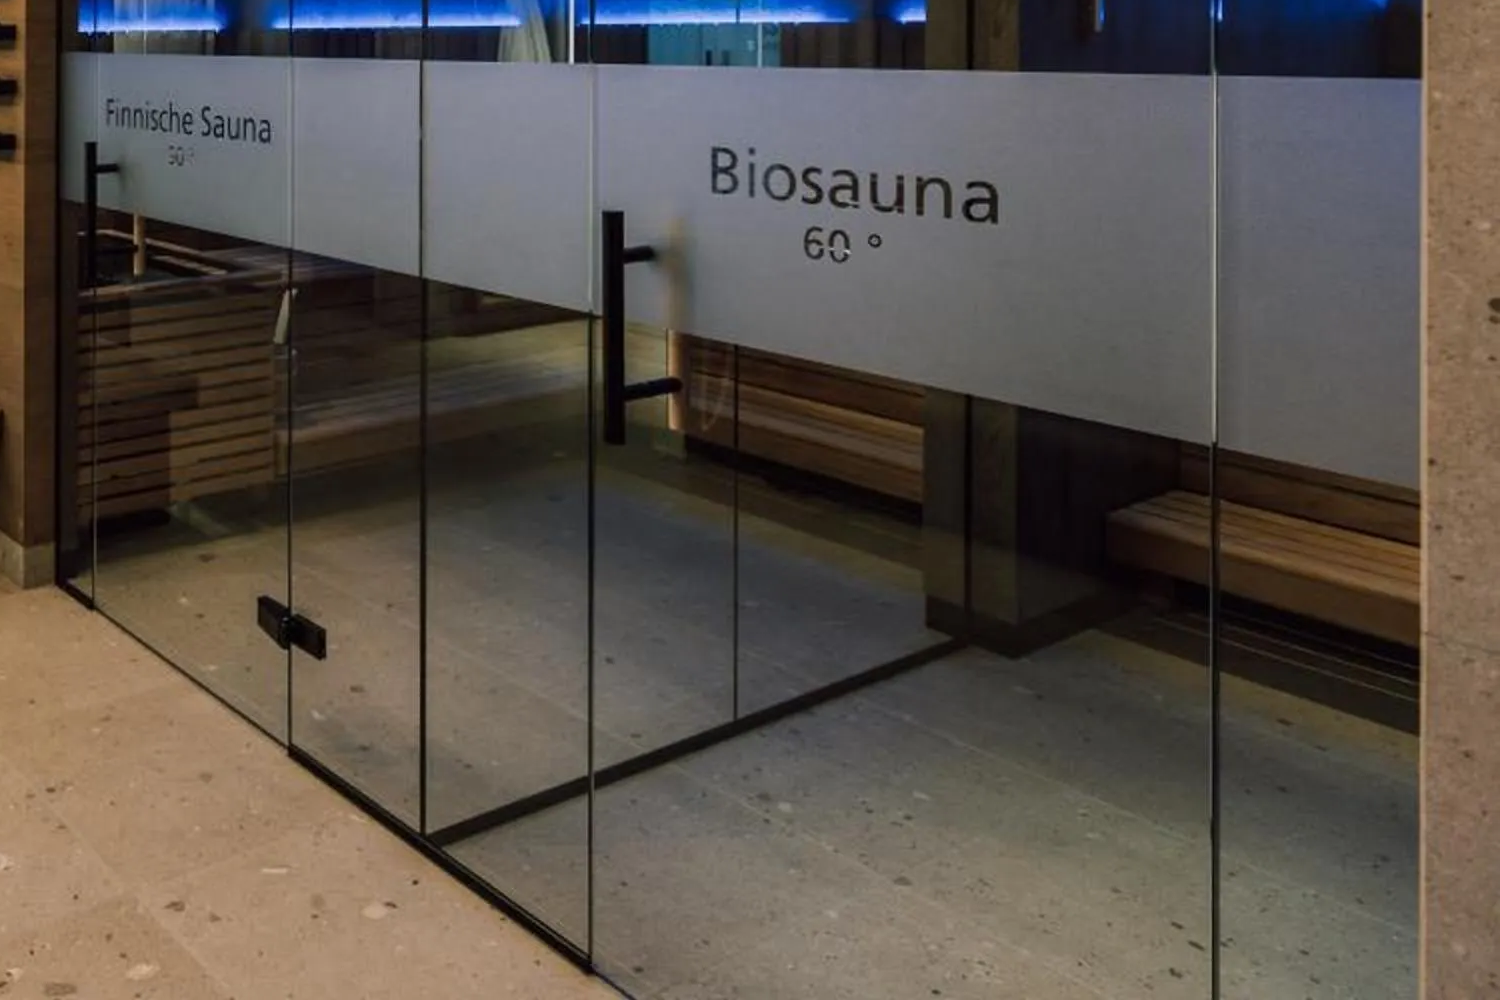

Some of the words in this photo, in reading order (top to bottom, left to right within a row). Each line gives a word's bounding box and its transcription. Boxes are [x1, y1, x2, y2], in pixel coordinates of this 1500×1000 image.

[105, 98, 194, 136] Finnische
[201, 105, 272, 144] Sauna
[710, 146, 999, 225] Biosauna
